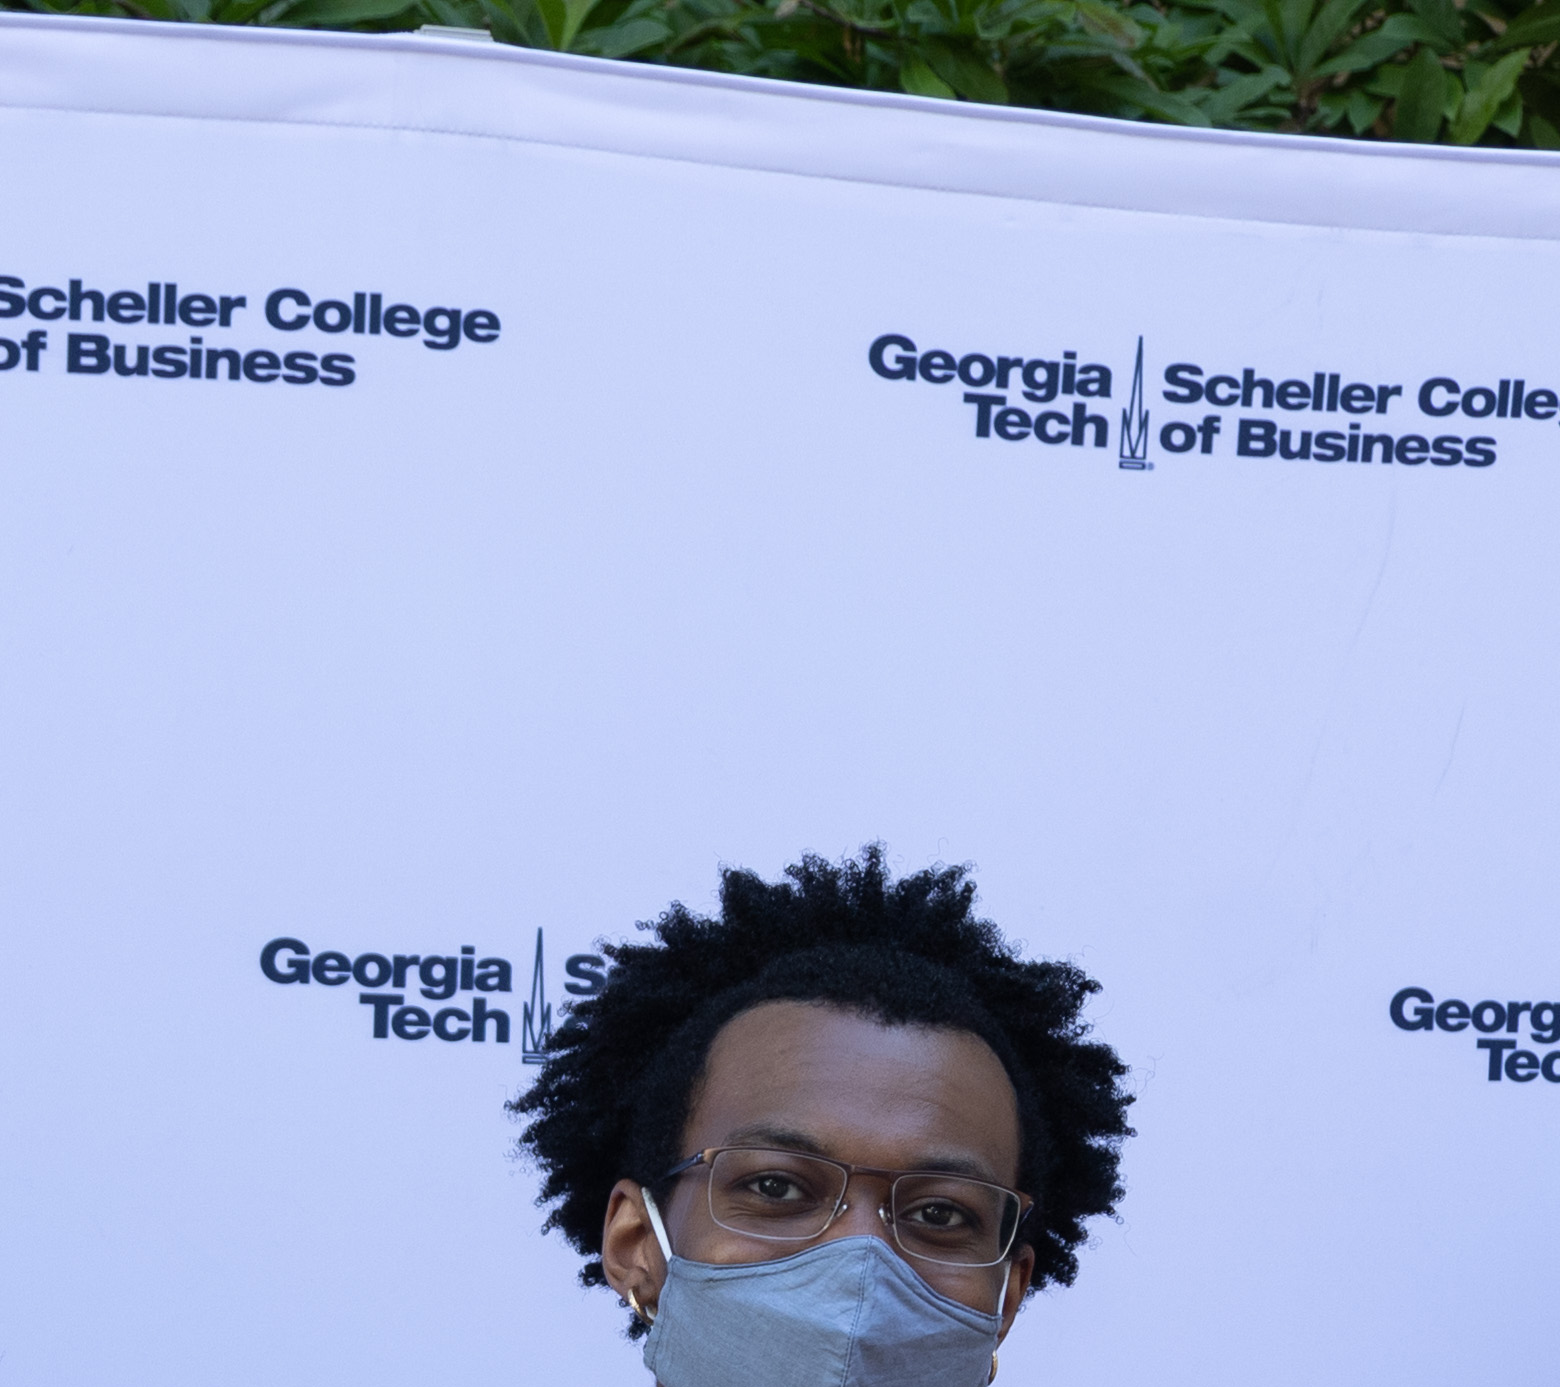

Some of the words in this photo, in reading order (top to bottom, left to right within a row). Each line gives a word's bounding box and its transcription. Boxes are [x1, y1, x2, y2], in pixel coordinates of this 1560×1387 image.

[265, 289, 500, 350] College
[67, 334, 355, 386] Business
[869, 335, 1111, 403] Georgia
[1163, 364, 1402, 414] Scheller
[964, 393, 1108, 447] Tech
[1160, 416, 1220, 454] of
[1237, 419, 1496, 467] Business
[260, 938, 511, 1000] Georgia
[360, 994, 509, 1043] Tech
